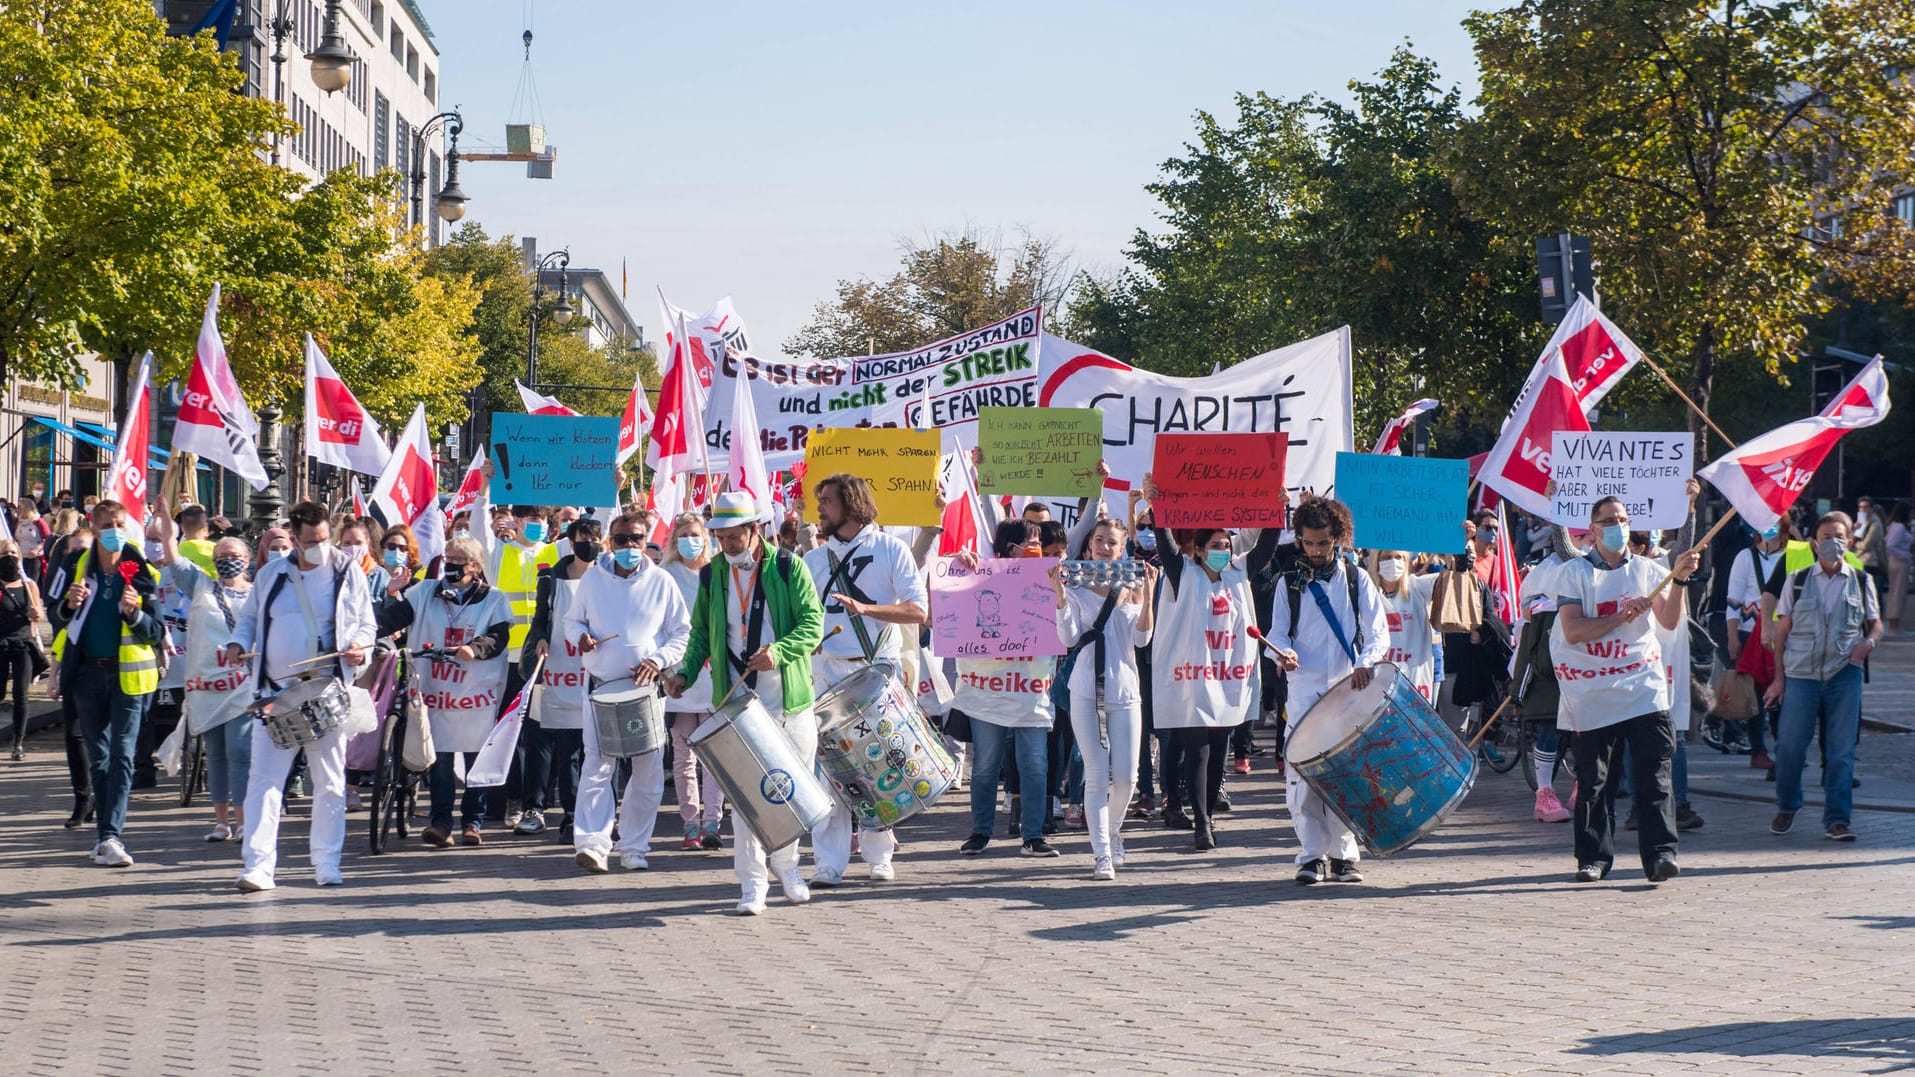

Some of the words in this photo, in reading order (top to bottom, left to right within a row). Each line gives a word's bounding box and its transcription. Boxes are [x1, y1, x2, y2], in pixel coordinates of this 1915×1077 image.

[806, 362, 846, 385] der
[856, 316, 1034, 382] NORMALZUSTAND
[779, 392, 821, 414] und
[828, 381, 887, 412] nicht
[895, 374, 936, 398] der
[943, 342, 1032, 387] STREIK
[706, 419, 731, 451] de
[911, 383, 1036, 426] GEFÄHRDE
[1008, 421, 1032, 430] KANN
[506, 425, 541, 443] Wenn
[547, 435, 565, 444] wir
[1046, 432, 1100, 448] ARBEITEN
[811, 446, 851, 458] NICHT
[858, 447, 888, 457] MEHR
[897, 446, 936, 457] SPAREN
[1165, 440, 1186, 456] Wir
[518, 455, 549, 468] dann
[992, 455, 1007, 464] WIE
[1010, 455, 1023, 464] ICH
[1026, 451, 1080, 465] BEZAHLT
[1000, 469, 1033, 480] WERDE
[1175, 462, 1265, 481] MENSCHEN
[1557, 465, 1582, 479] HAT
[1592, 465, 1624, 479] VIELE
[1631, 464, 1680, 479] TÖCHTER
[558, 481, 583, 490] nur
[1558, 483, 1588, 497] ABER
[1597, 483, 1627, 495] KEINE
[1164, 508, 1225, 524] KRANKE
[1231, 506, 1282, 523] SYSTEM
[936, 561, 966, 577] Ohne
[975, 567, 993, 576] uns
[1006, 565, 1021, 575] ist
[1205, 630, 1236, 650] Wir
[958, 643, 989, 654] alles
[1586, 639, 1628, 659] Wir
